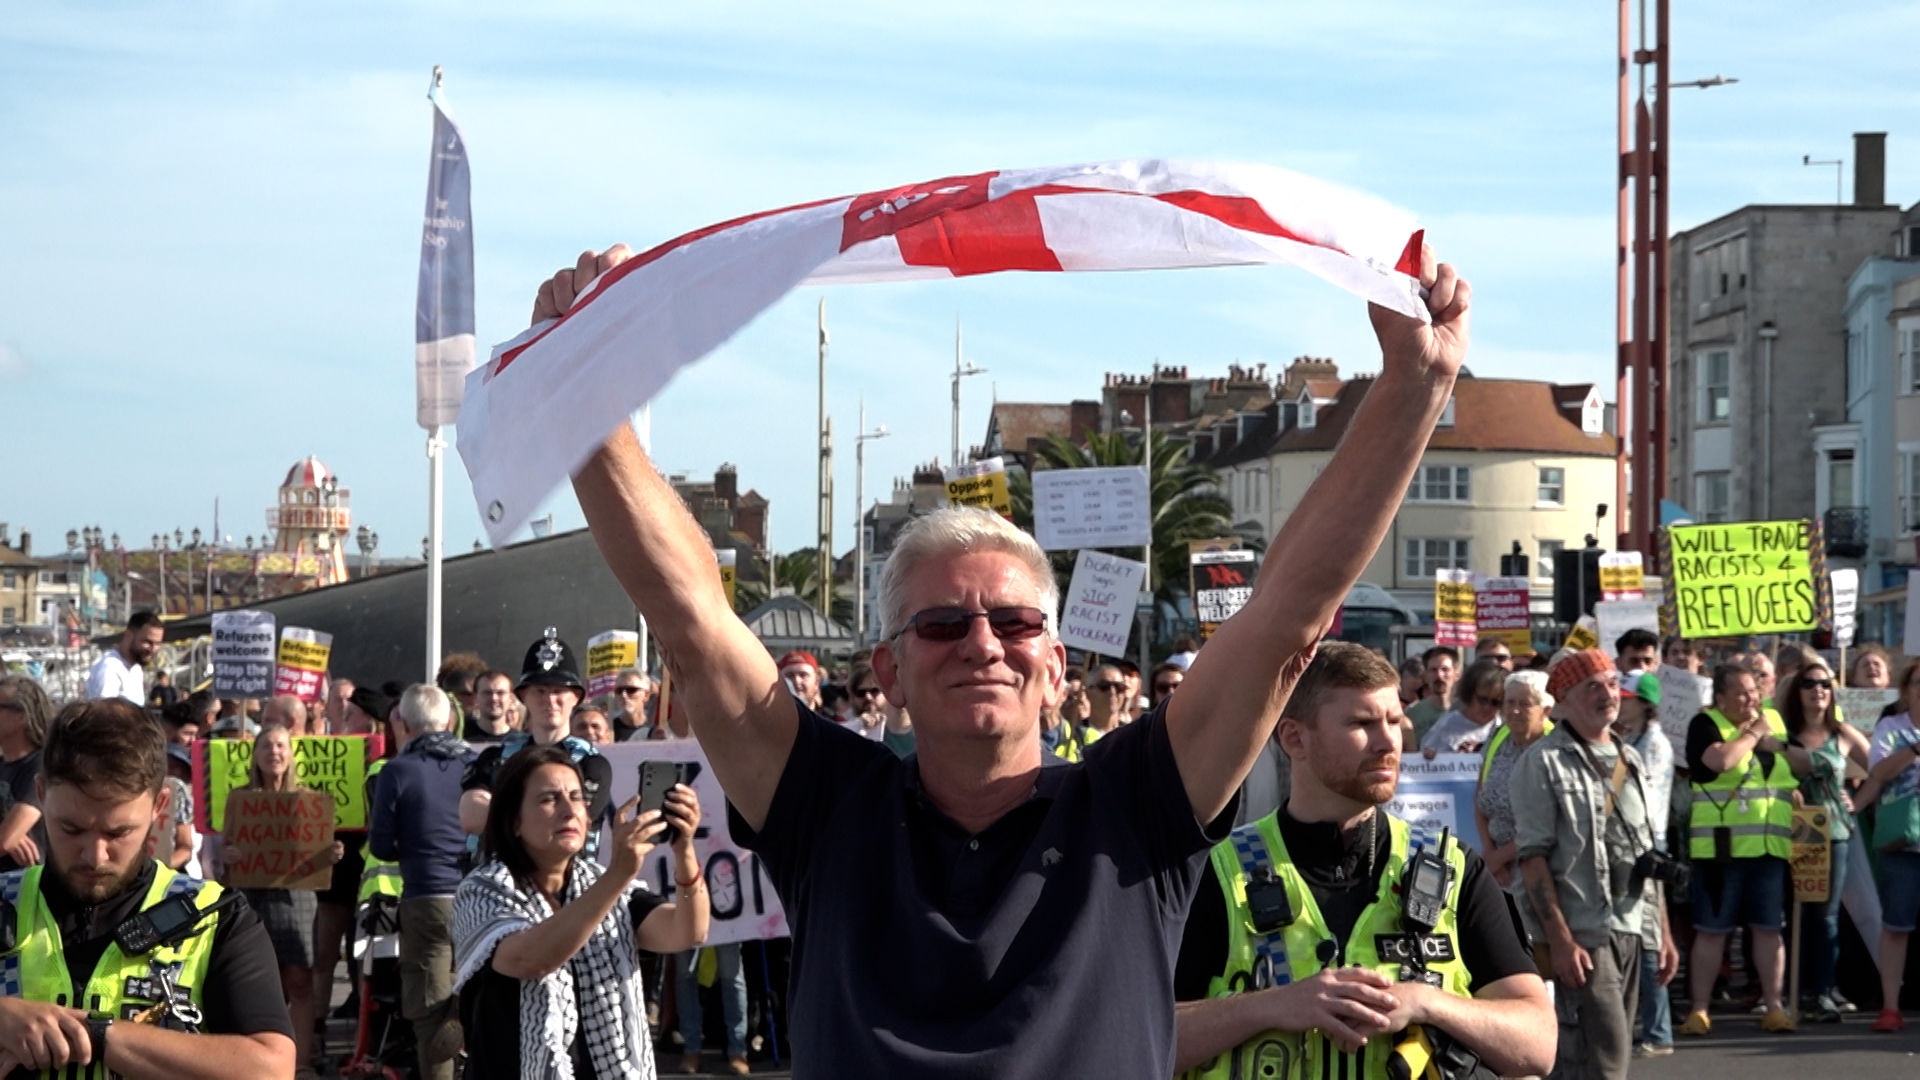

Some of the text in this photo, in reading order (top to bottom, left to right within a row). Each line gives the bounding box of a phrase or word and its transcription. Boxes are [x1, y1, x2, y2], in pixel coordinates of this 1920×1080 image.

[949, 479, 993, 495] Oppose
[1673, 523, 1810, 552] WILL TRADE
[1084, 556, 1133, 577] DORSET
[1678, 554, 1796, 581] RACISTS 4
[1082, 588, 1117, 604] STOP
[1477, 593, 1521, 606] Climate
[1680, 579, 1814, 630] REFUGEES
[1070, 605, 1121, 626] RACIST
[1477, 605, 1527, 618] refugees
[215, 629, 273, 642] Refugees
[1068, 624, 1126, 646] VIOLENCE
[215, 645, 270, 656] welcome
[215, 663, 269, 678] Stop the
[215, 677, 267, 694] far right
[226, 738, 348, 762] POAND
[1401, 761, 1455, 774] Portland
[242, 796, 324, 820] NANAS
[1408, 800, 1449, 813] wages
[236, 822, 332, 846] AGAINST
[234, 850, 315, 876] NAZIS
[1382, 937, 1450, 957] POICE
